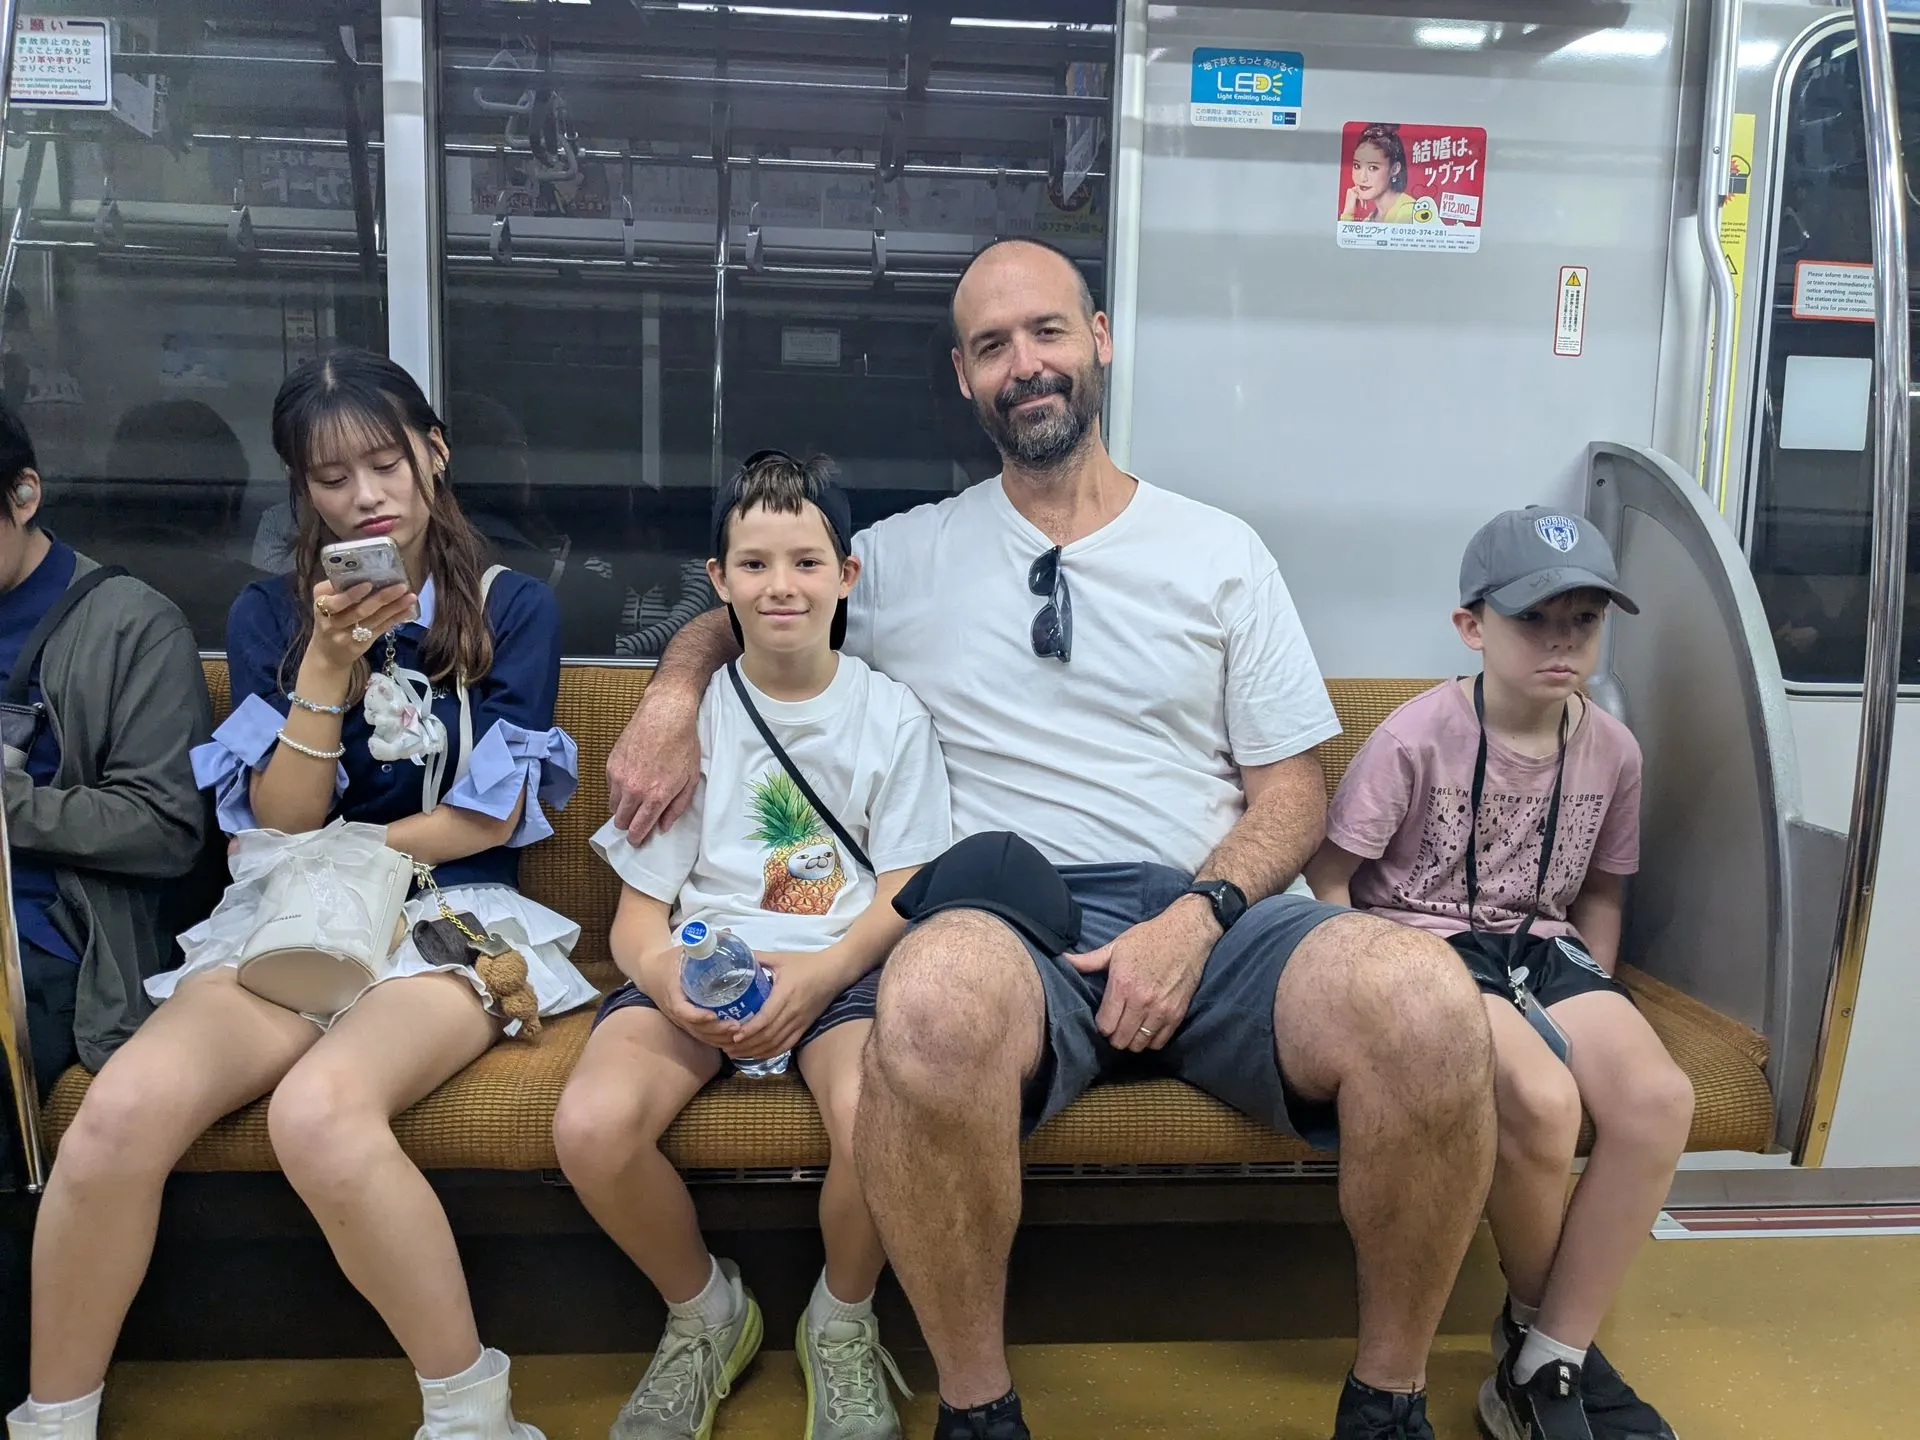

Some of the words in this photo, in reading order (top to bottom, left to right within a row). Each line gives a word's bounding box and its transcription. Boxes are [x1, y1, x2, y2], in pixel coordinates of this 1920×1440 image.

[1217, 71, 1272, 94] LED
[1234, 94, 1259, 102] Emitting
[1424, 159, 1478, 188] ツヴァイ
[1399, 228, 1448, 237] 0120-374-281
[1837, 281, 1867, 289] immediately
[1824, 288, 1846, 296] anything
[1539, 516, 1573, 528] ROBINA
